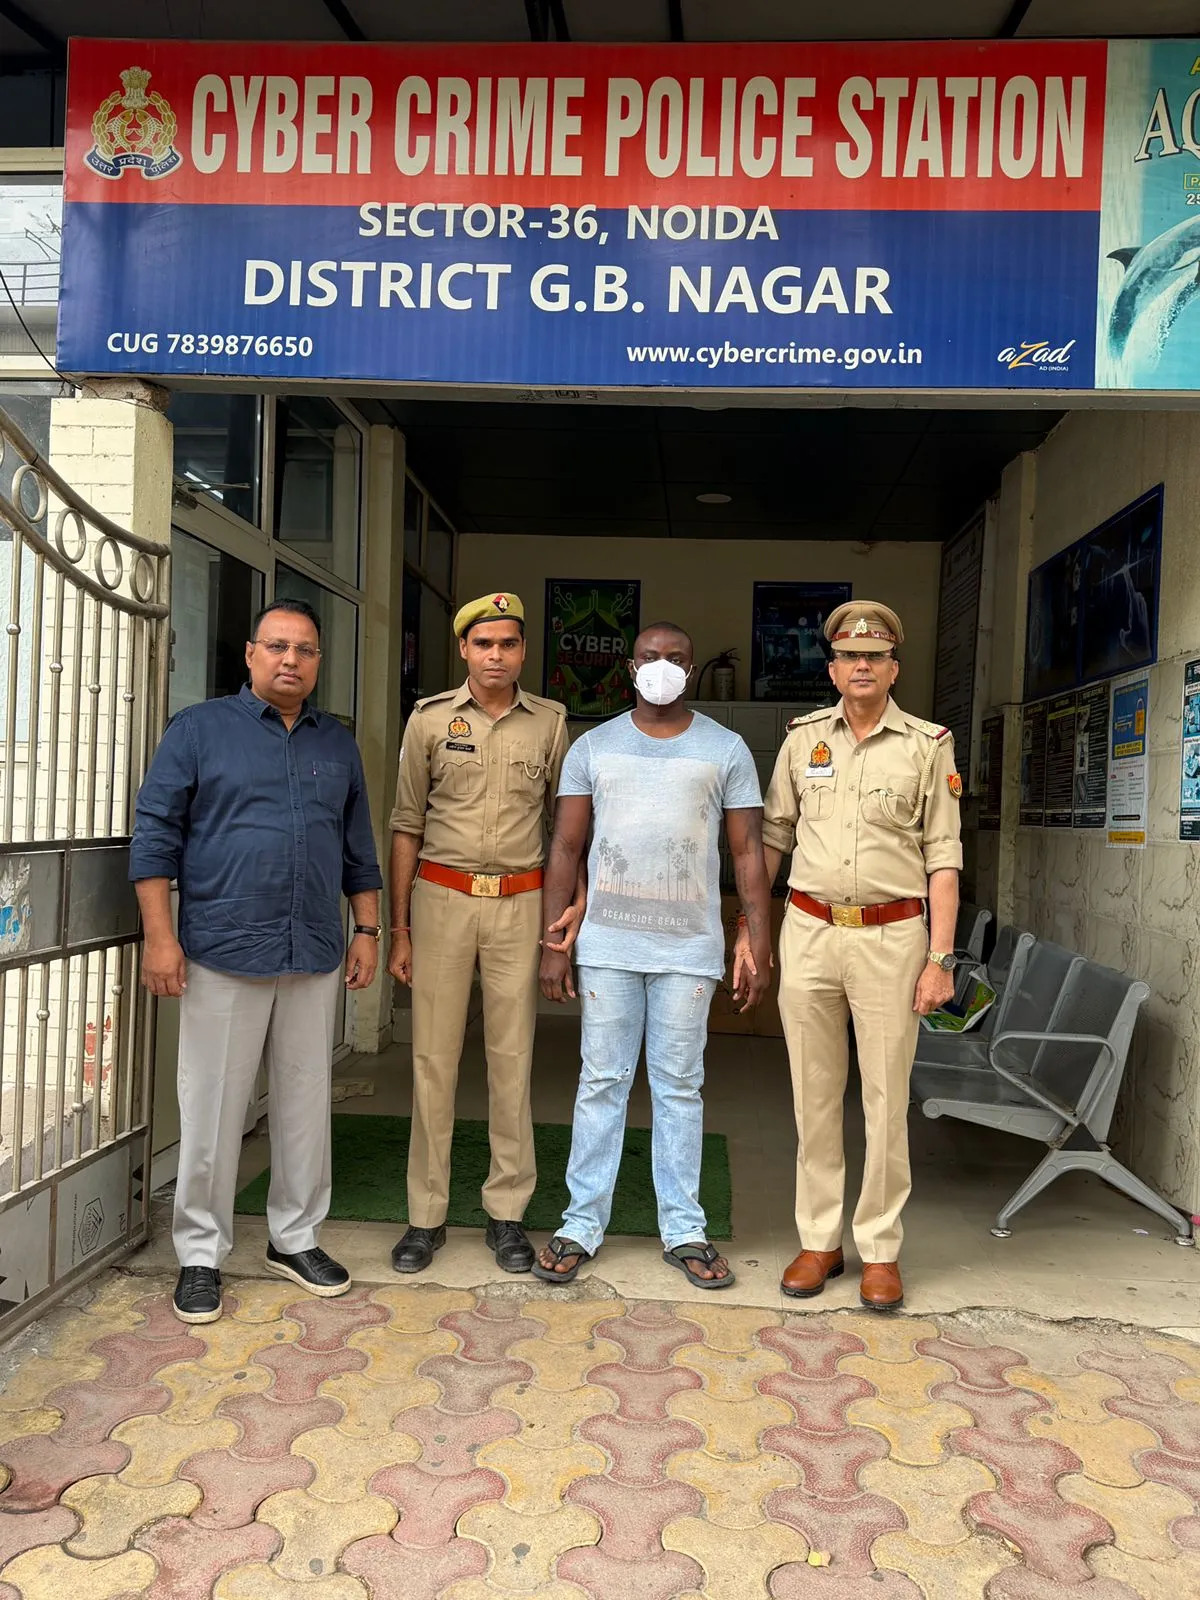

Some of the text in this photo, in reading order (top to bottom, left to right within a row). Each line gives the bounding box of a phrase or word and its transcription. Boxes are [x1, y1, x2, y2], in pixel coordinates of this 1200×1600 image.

[191, 74, 1087, 179] CYBER CRIME POLICE STATION
[91, 154, 178, 176] उत्तर प्रदेश पुलिस
[358, 202, 780, 246] SECTOR-36, NOIDA
[244, 260, 894, 315] DISTRICT G.B. NAGAR
[107, 332, 313, 357] CUG 7839876650
[626, 341, 922, 369] www.cybercrime.gov.in
[560, 632, 625, 654] CYBER
[557, 651, 627, 667] SECURITY
[602, 907, 654, 925] OCEANSIDE
[657, 915, 689, 927] BEACH
